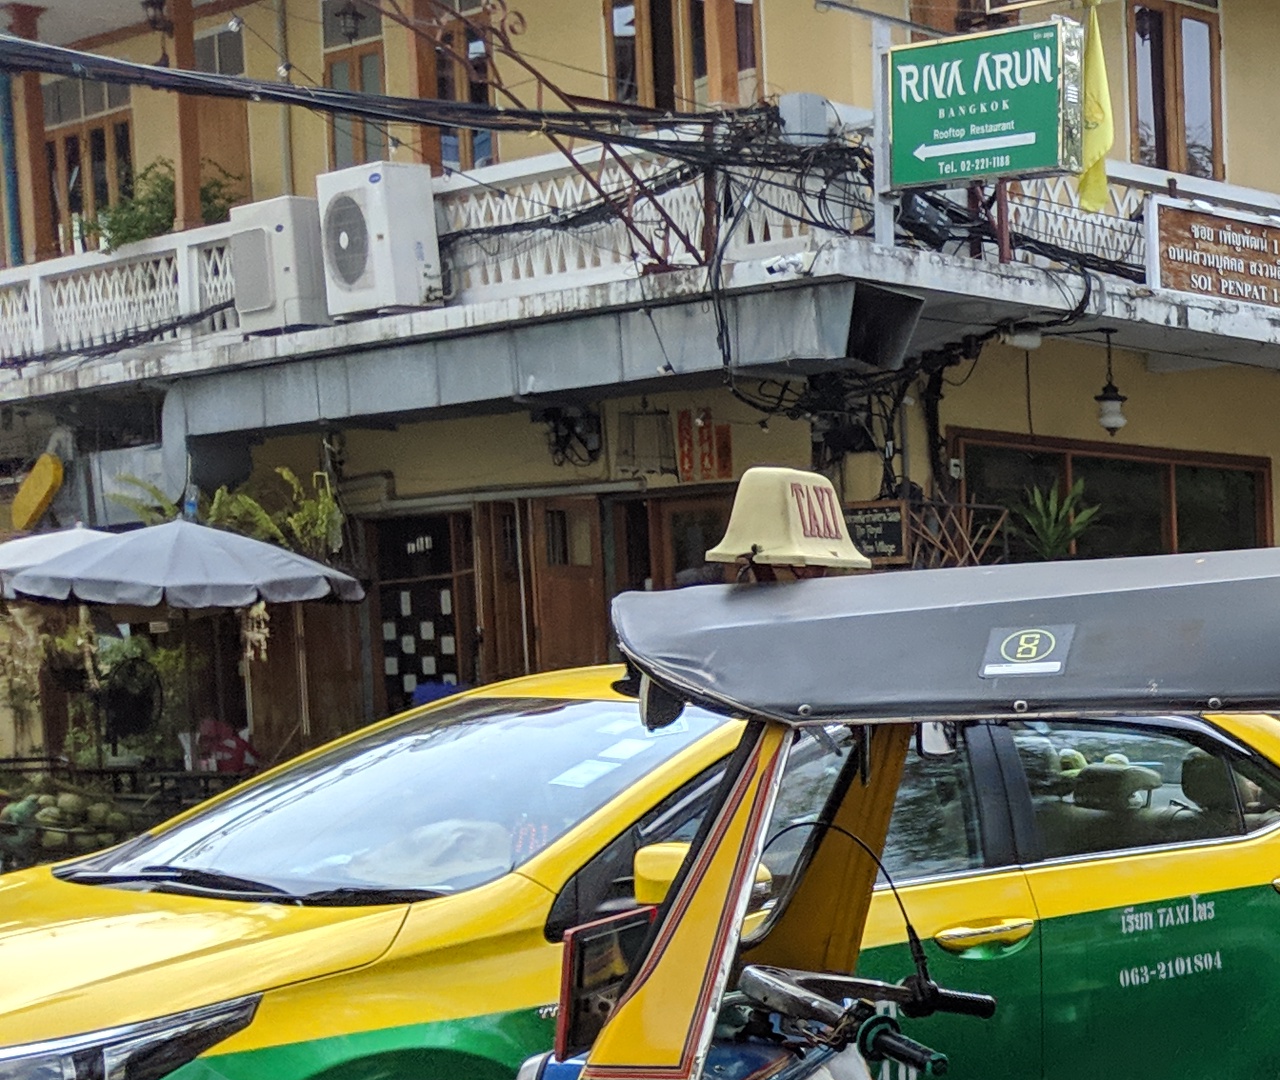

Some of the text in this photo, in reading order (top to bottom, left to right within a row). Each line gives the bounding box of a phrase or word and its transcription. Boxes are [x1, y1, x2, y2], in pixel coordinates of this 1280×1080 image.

[896, 46, 1054, 103] RIVA ARUN
[938, 99, 1010, 119] BANGKOK
[933, 120, 1015, 141] Rooftop Restaurant
[938, 155, 1011, 175] Tel. 02-221-1188
[1191, 224, 1279, 255] ซอย เพ็ญพัฒน์ 1
[1168, 242, 1245, 275] ถนนส่วนบุคคล
[1191, 274, 1279, 304] SOI PENPAT 1
[791, 483, 842, 540] TAXI
[1121, 893, 1215, 934] เรียก TAXI โทร
